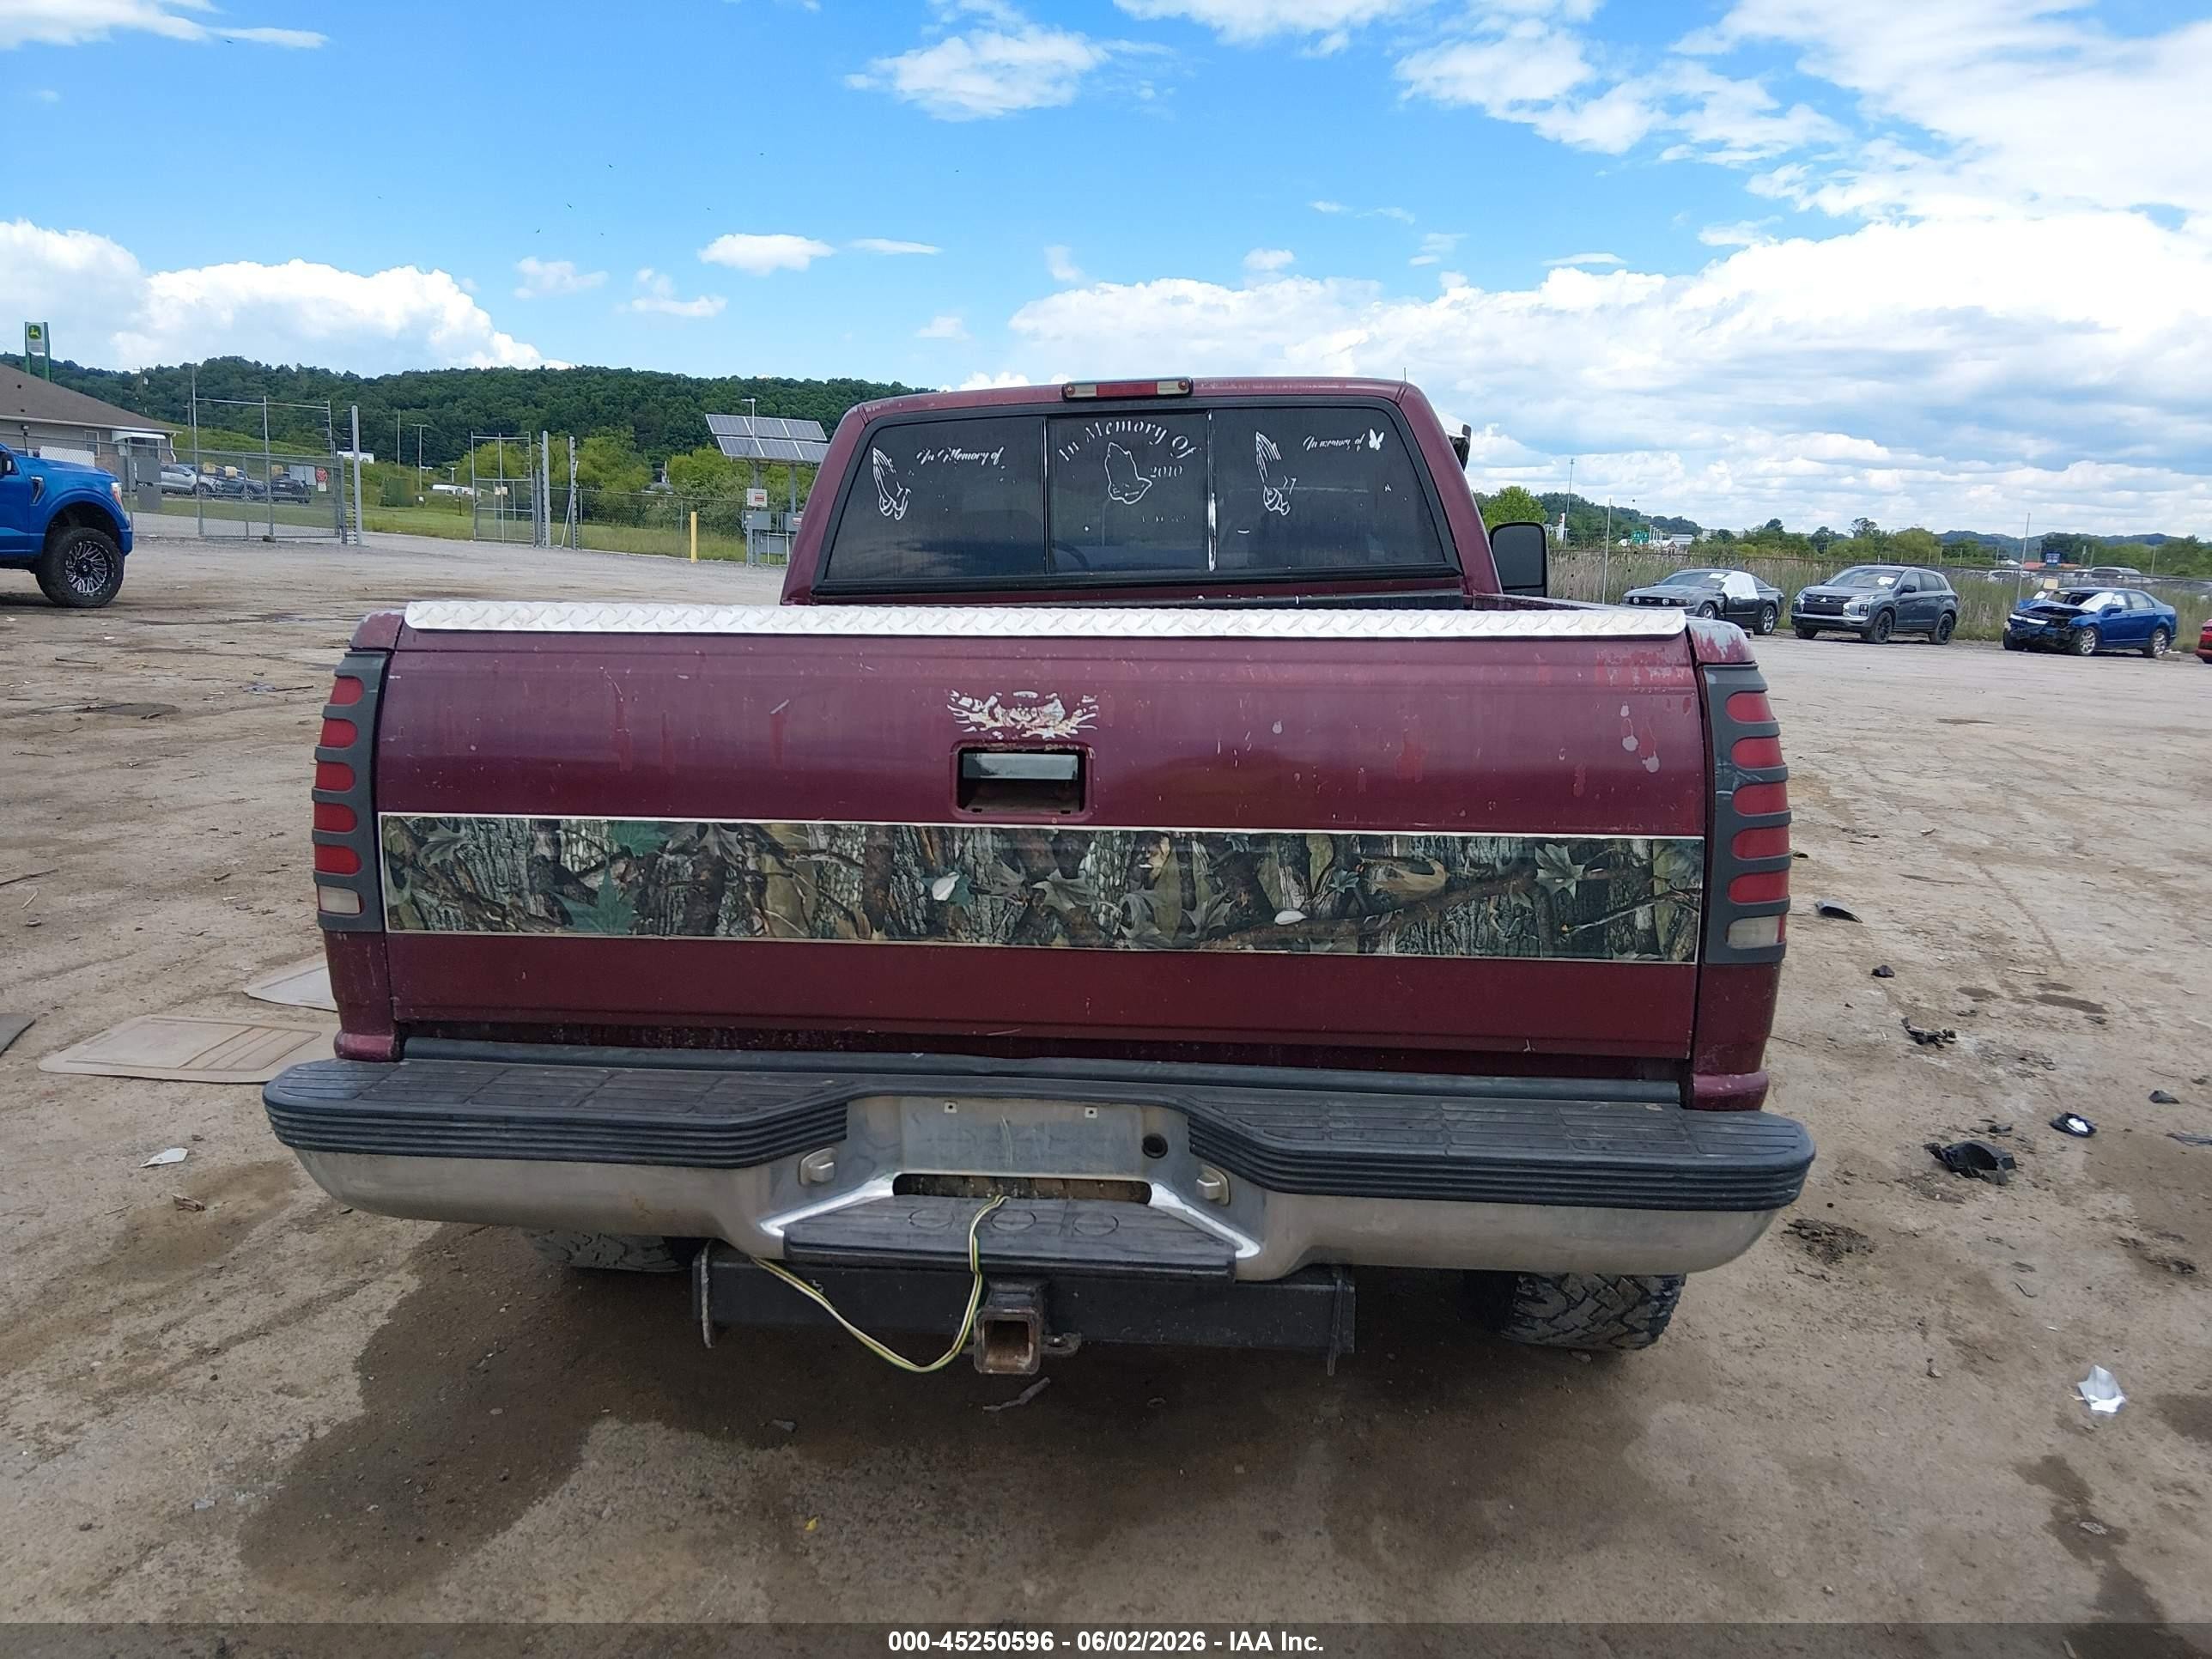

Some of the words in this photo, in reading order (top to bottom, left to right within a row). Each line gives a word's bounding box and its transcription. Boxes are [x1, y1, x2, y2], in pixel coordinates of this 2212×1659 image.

[1059, 441, 1079, 461] In
[1086, 421, 1167, 445] Memory
[1170, 435, 1197, 459] Of
[990, 447, 1005, 465] of
